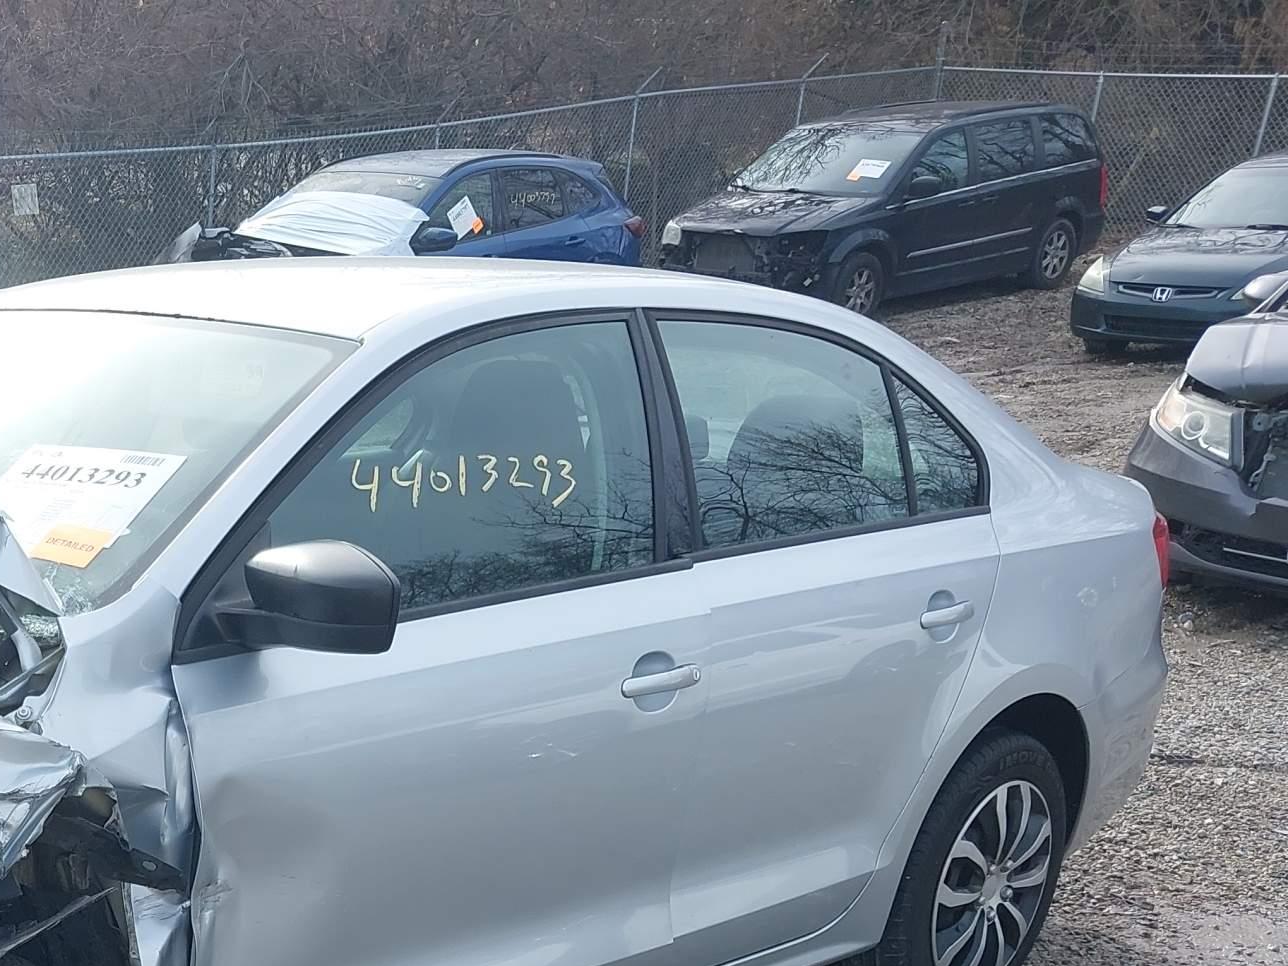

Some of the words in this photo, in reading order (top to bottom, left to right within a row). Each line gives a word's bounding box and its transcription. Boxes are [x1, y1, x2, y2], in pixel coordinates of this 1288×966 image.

[21, 463, 147, 489] 44013293
[351, 454, 577, 513] 44013293
[45, 536, 95, 553] DETAILED
